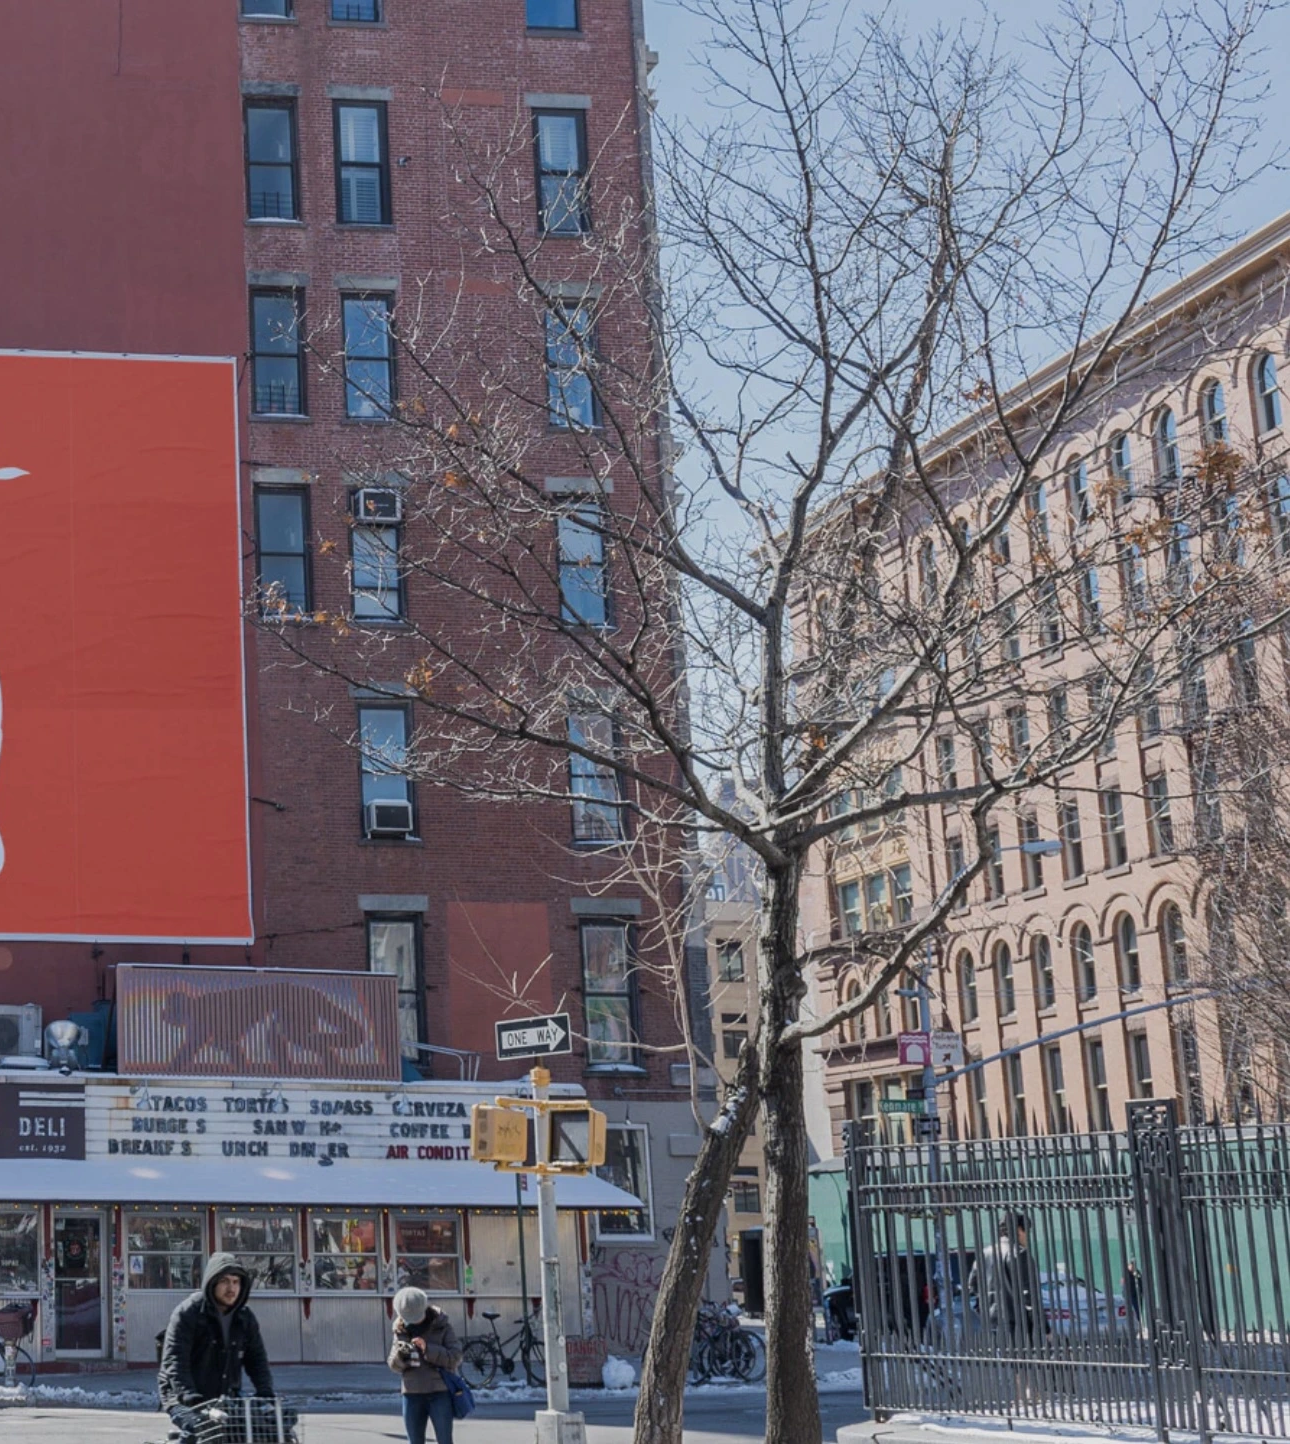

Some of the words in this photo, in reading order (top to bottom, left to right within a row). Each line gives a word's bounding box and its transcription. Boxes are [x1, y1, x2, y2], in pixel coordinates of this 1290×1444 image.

[507, 1031, 528, 1047] ONE
[537, 1028, 558, 1043] WAY
[151, 1095, 208, 1112] TACOS
[19, 1117, 66, 1137] DELI
[389, 1122, 450, 1139] COFFEE
[386, 1144, 409, 1160] AIR
